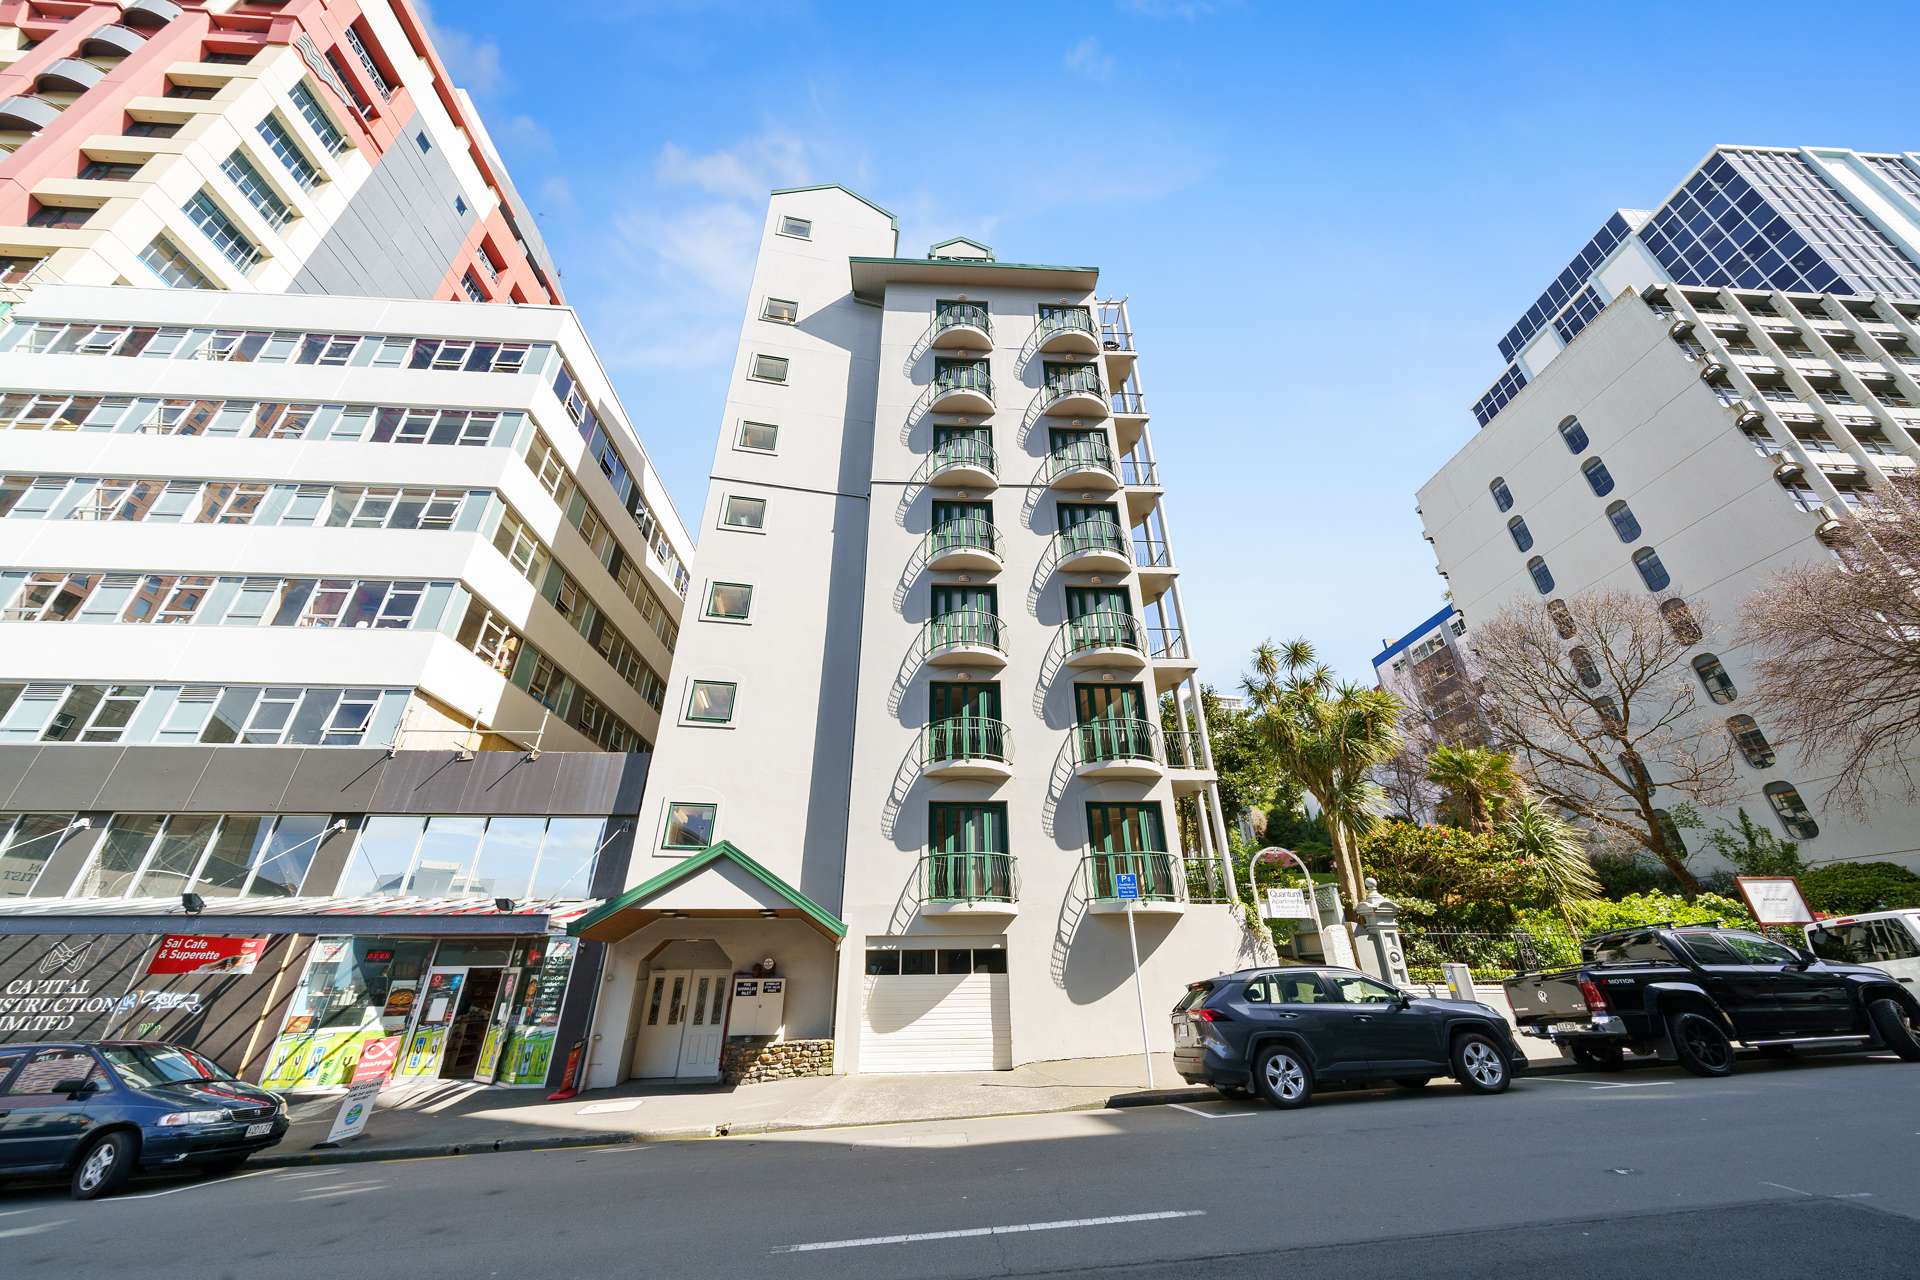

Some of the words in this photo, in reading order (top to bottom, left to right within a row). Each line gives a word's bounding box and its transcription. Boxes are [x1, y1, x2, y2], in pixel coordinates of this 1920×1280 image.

[184, 939, 208, 949] Cafe
[159, 949, 167, 959] &
[169, 950, 220, 961] Superette
[6, 979, 91, 995] CAPITAL
[0, 1015, 75, 1031] IMITED
